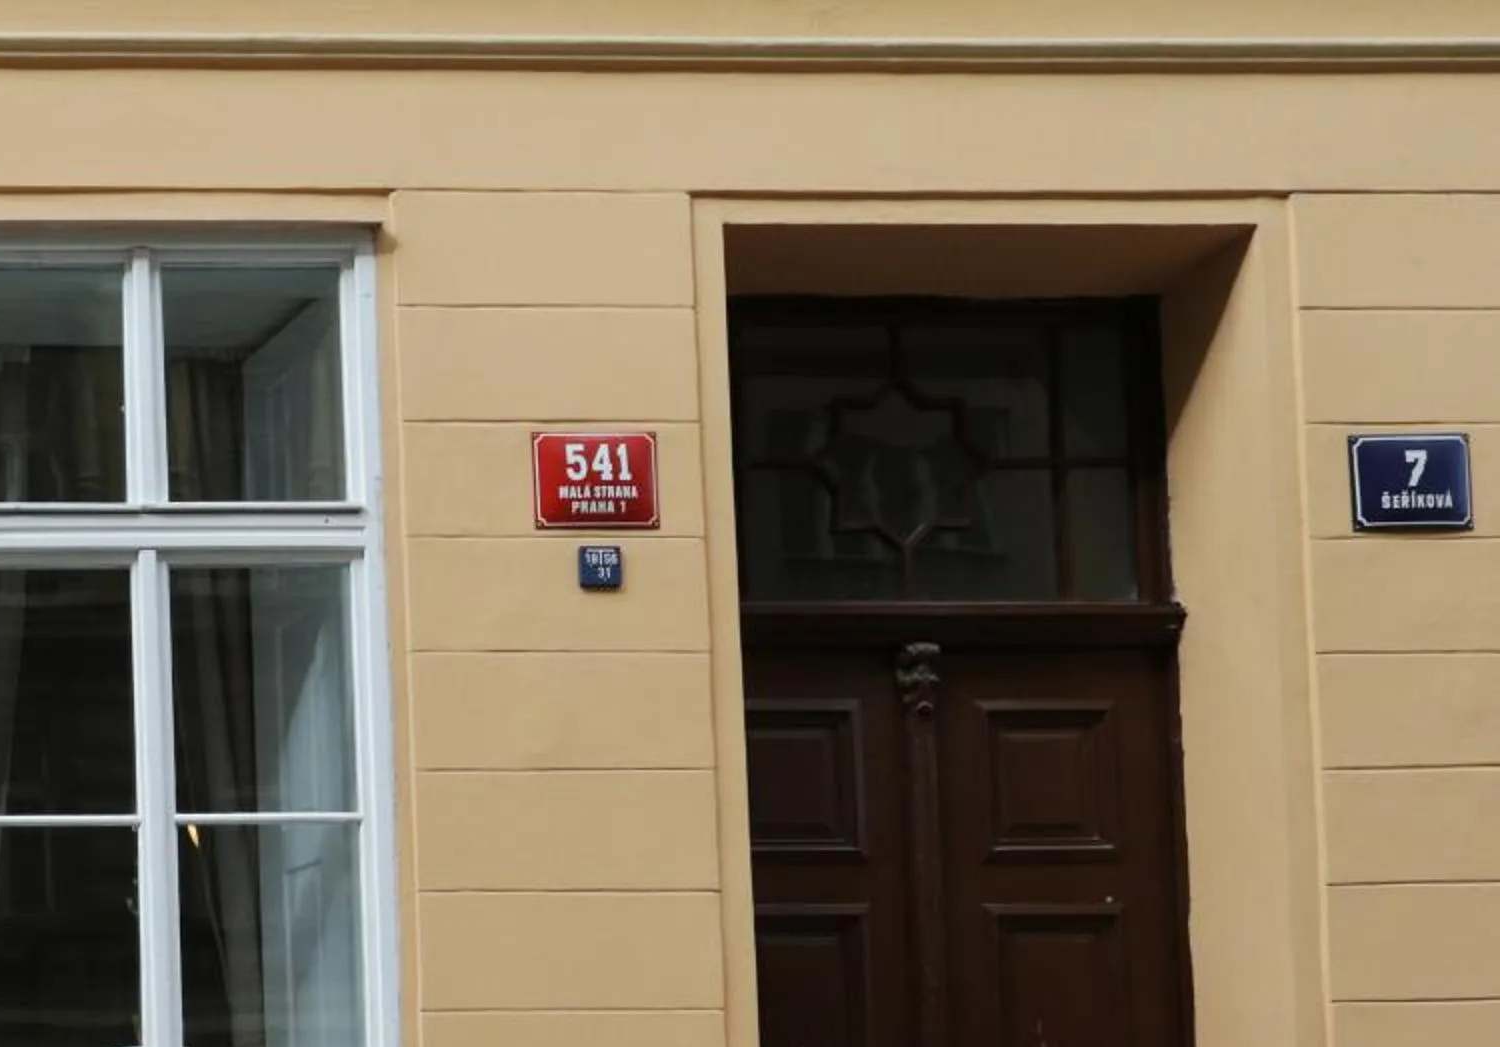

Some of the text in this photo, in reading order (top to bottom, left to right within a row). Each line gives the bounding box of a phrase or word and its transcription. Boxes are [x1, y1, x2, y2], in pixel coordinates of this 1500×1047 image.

[564, 443, 633, 481] 541
[1404, 449, 1427, 487] 7
[594, 485, 638, 499] STRANA
[1381, 488, 1453, 509] ŠEŘÍKOVÁ
[572, 500, 627, 514] PRAHA 1
